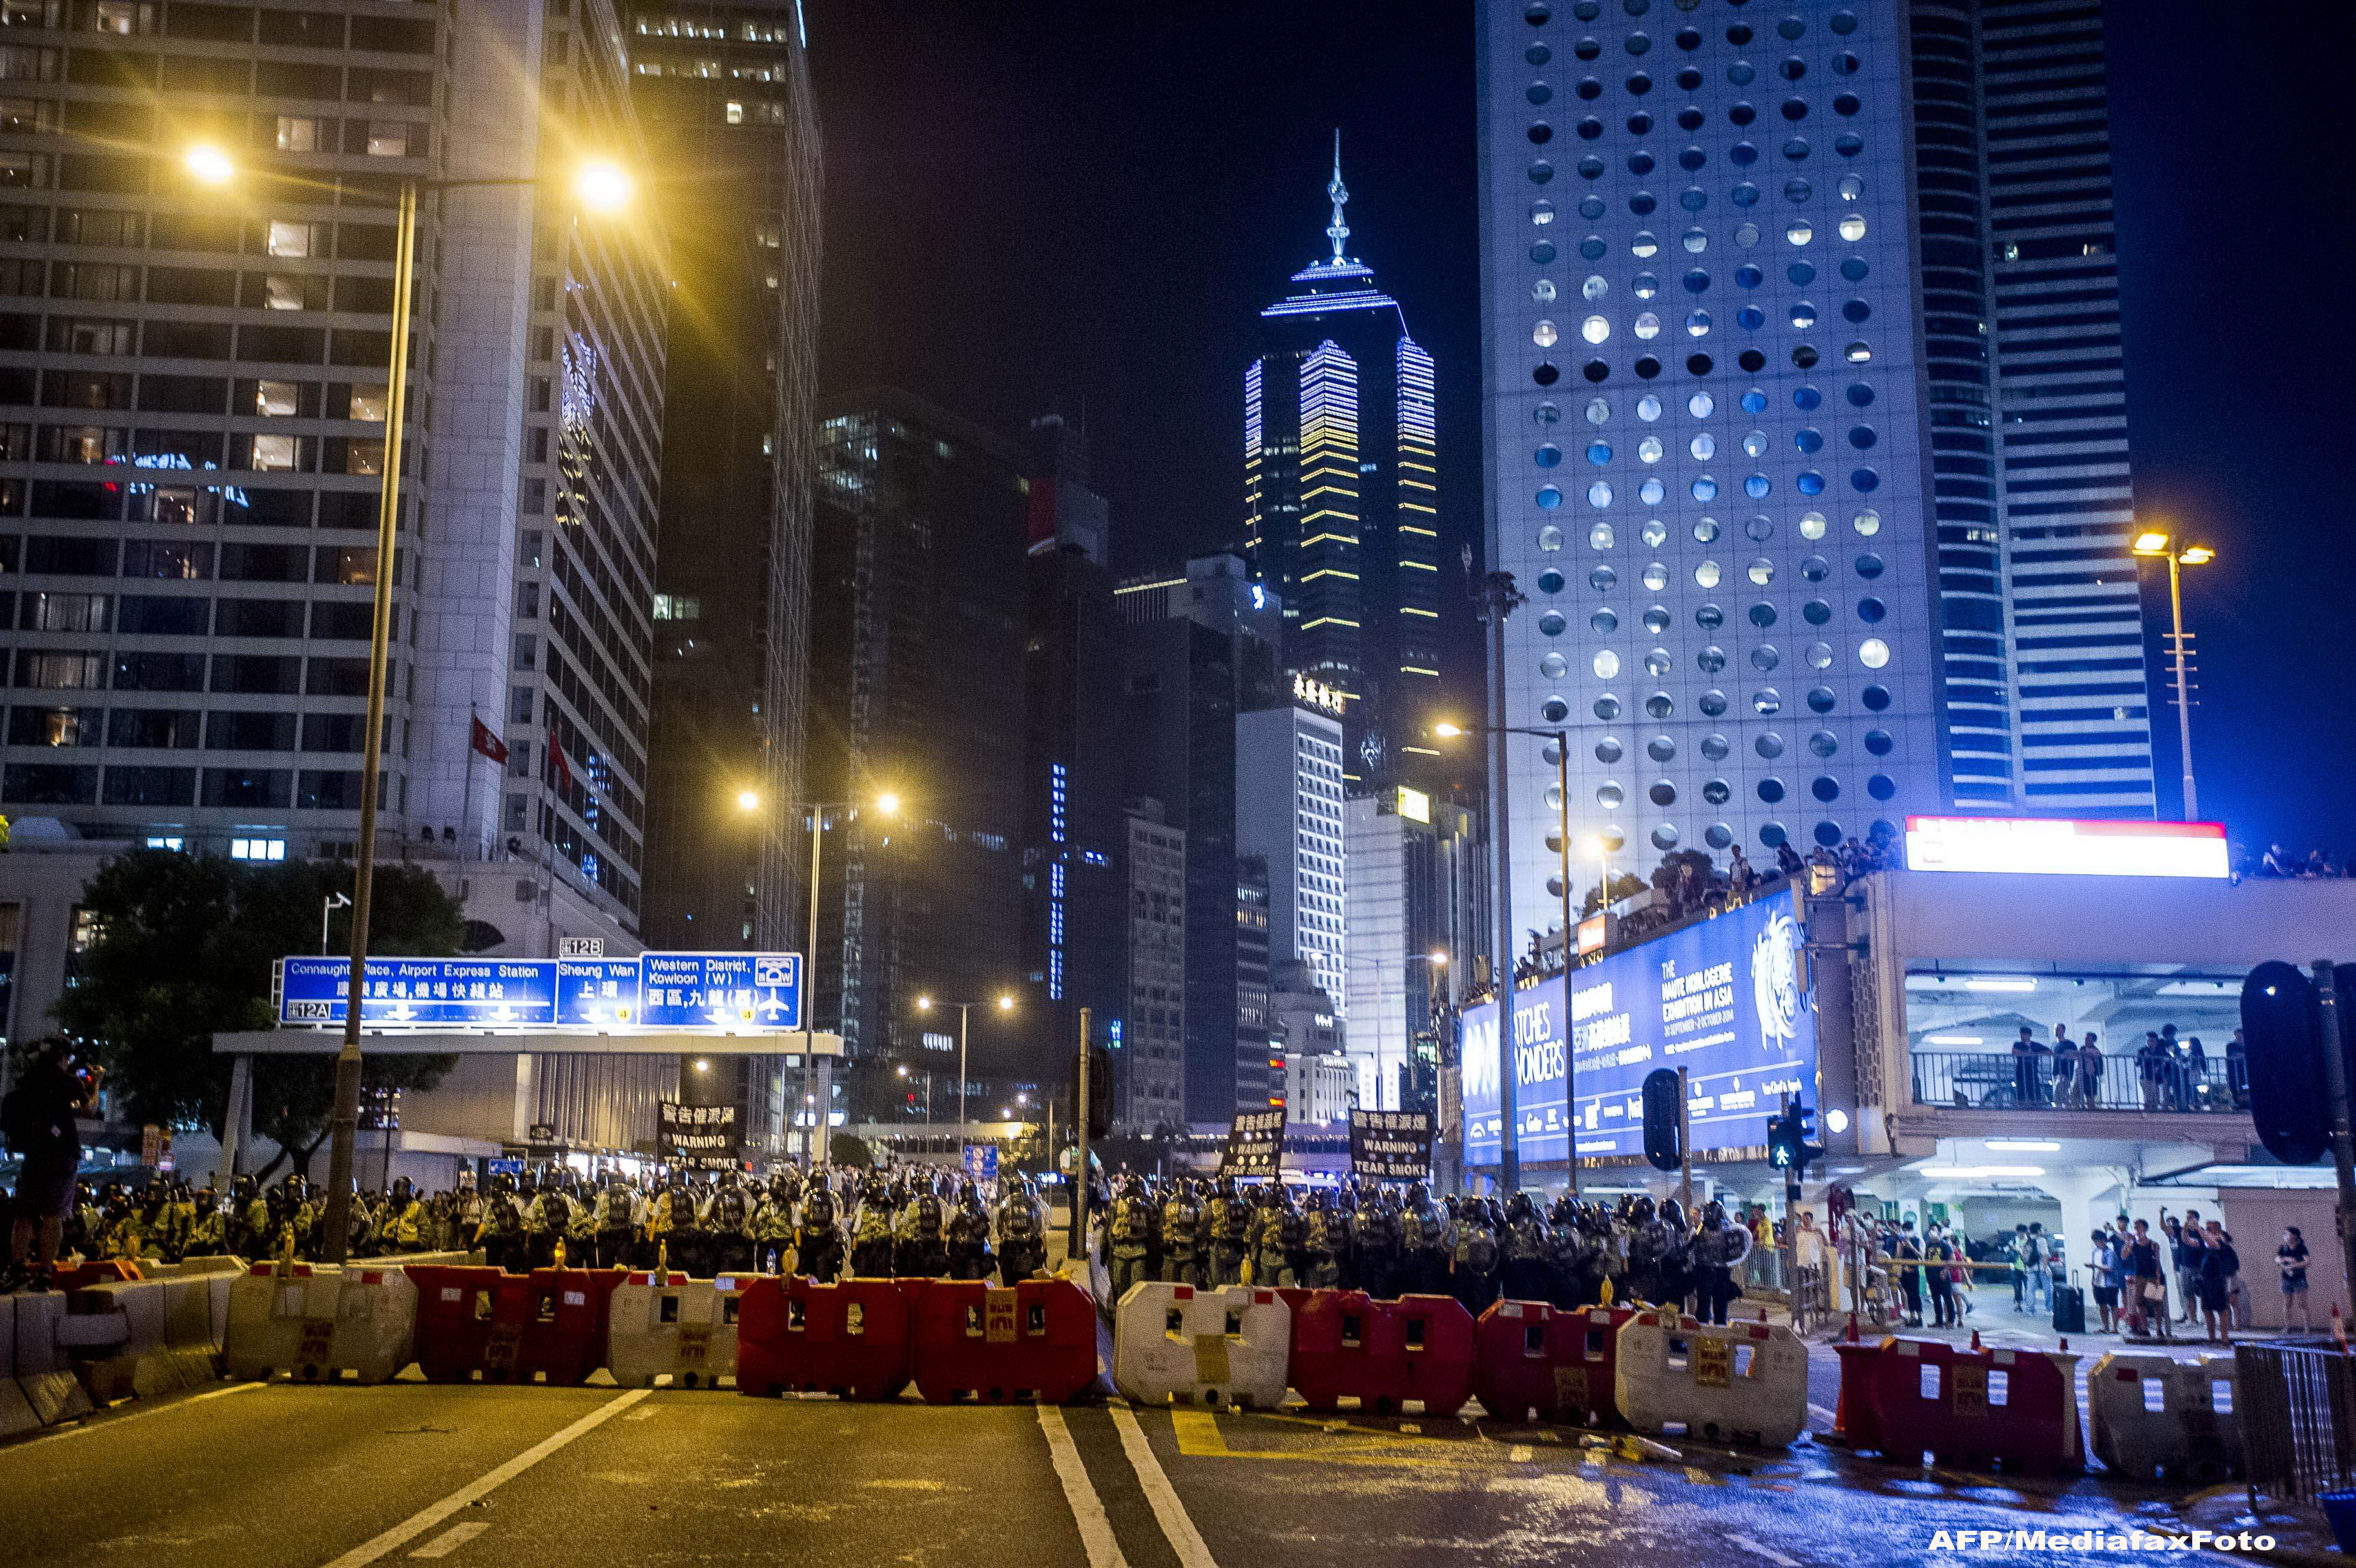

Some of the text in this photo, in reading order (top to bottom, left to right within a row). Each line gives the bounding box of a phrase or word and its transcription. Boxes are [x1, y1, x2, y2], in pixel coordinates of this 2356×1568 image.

[572, 940, 600, 954] 12B
[291, 962, 350, 978] Connaught
[399, 964, 437, 978] Airport
[445, 964, 491, 978] Express
[498, 965, 538, 978] Station
[560, 964, 635, 978] Sheung Wan
[650, 958, 750, 973] Western District,
[1661, 959, 1676, 980] THE
[648, 972, 698, 985] Kowloon
[1713, 984, 1735, 1008] ASIA
[299, 1002, 328, 1018] 12A
[672, 1133, 726, 1149] WARNING
[1237, 1142, 1273, 1155] WARNING
[1363, 1139, 1417, 1155] WARNING
[664, 1156, 737, 1170] TEAR SMOKE
[1223, 1165, 1276, 1176] TEAR SMOKE
[1355, 1160, 1427, 1176] TEAR SMOKE
